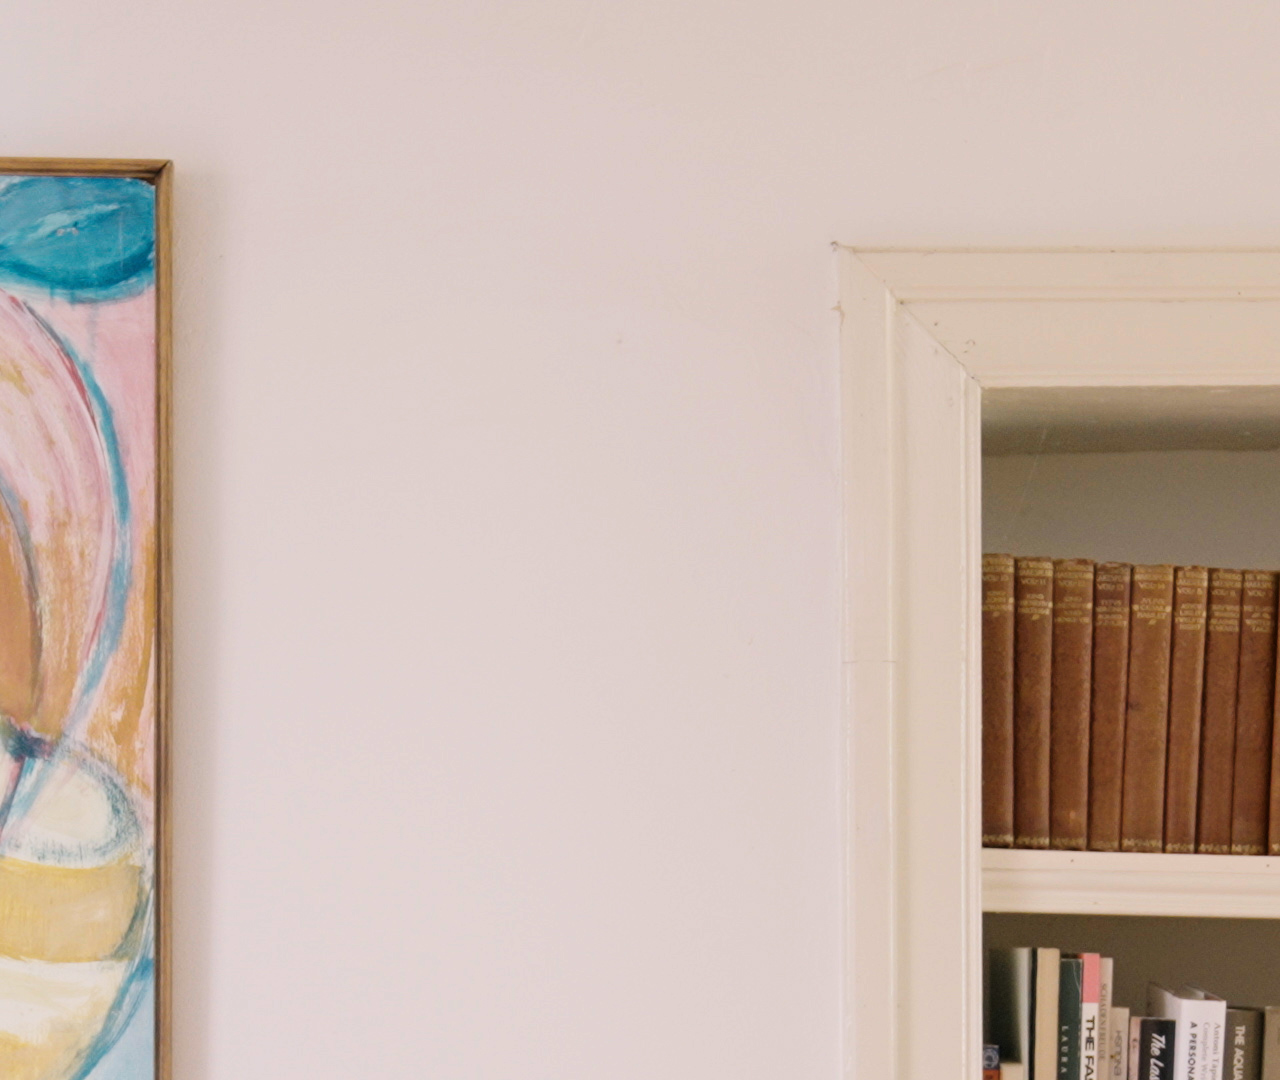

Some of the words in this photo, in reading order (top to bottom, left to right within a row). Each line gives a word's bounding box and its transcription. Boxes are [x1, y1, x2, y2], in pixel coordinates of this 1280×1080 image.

[1084, 1015, 1096, 1052] THE
[1150, 1033, 1166, 1055] The
[1234, 1025, 1246, 1045] THE
